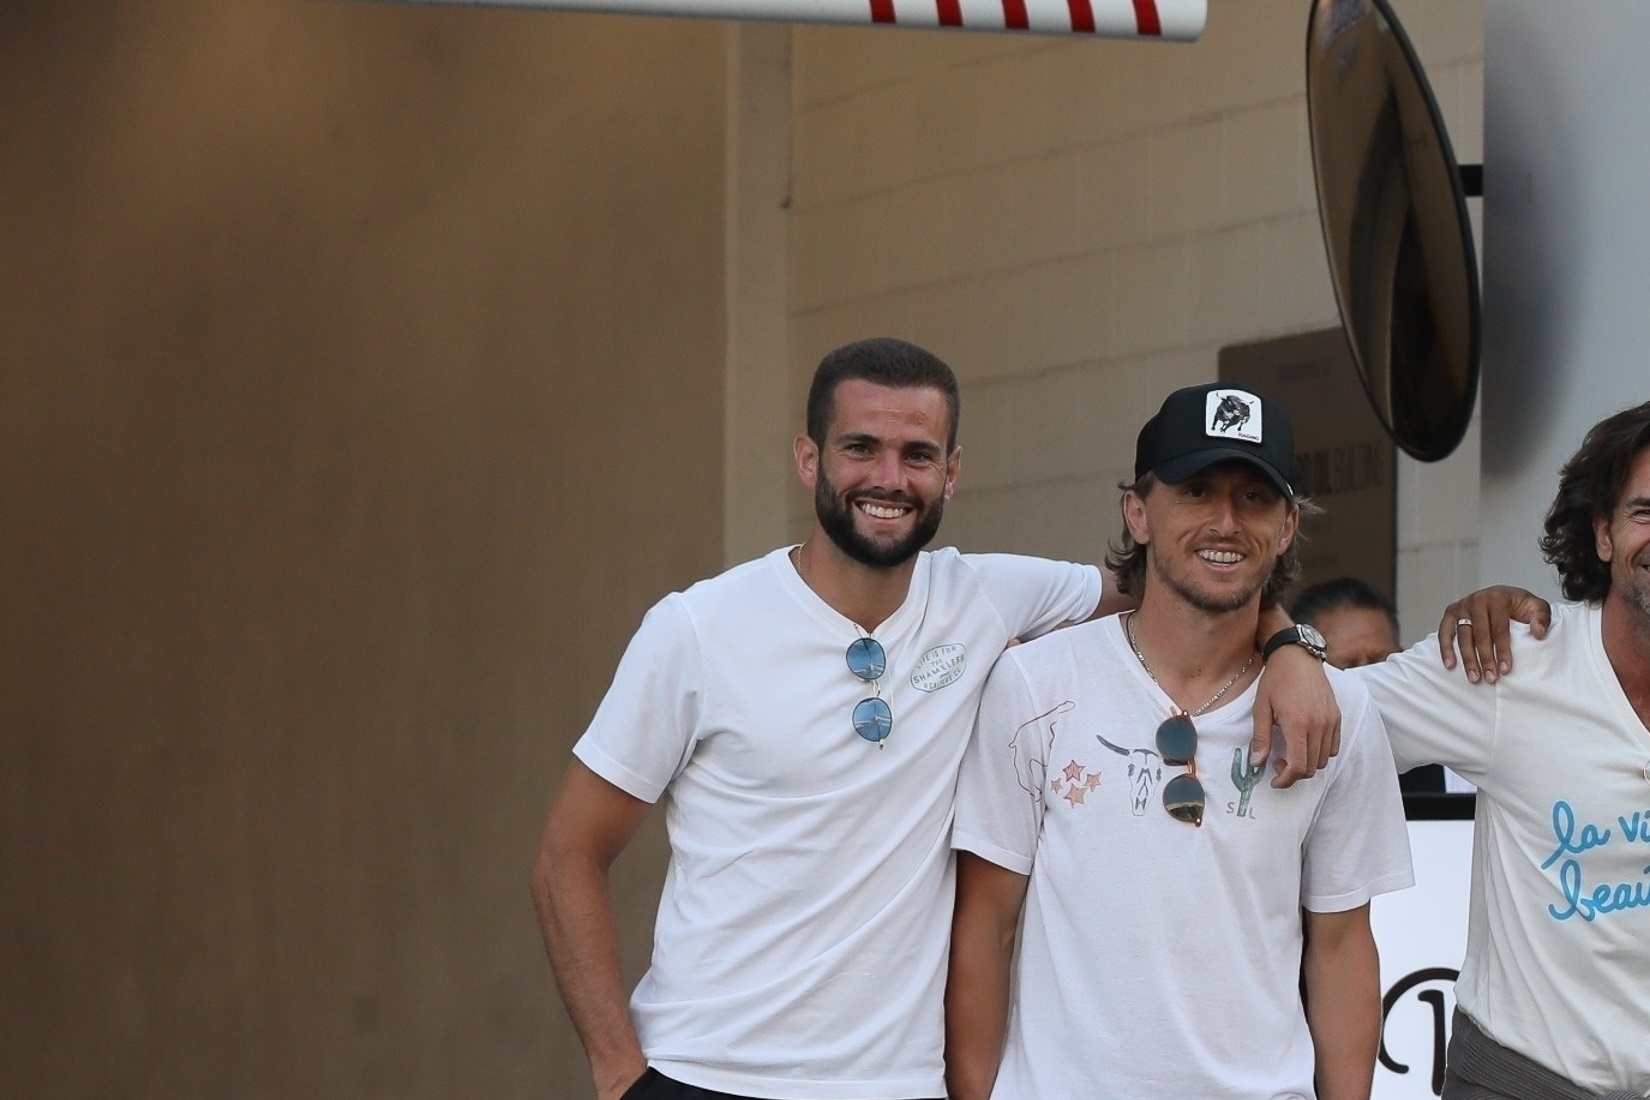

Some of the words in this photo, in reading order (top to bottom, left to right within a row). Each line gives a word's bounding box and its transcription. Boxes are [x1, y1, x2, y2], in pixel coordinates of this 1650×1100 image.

[941, 646, 956, 655] FOR
[913, 653, 965, 684] SHAMELESS
[1541, 800, 1611, 870] la
